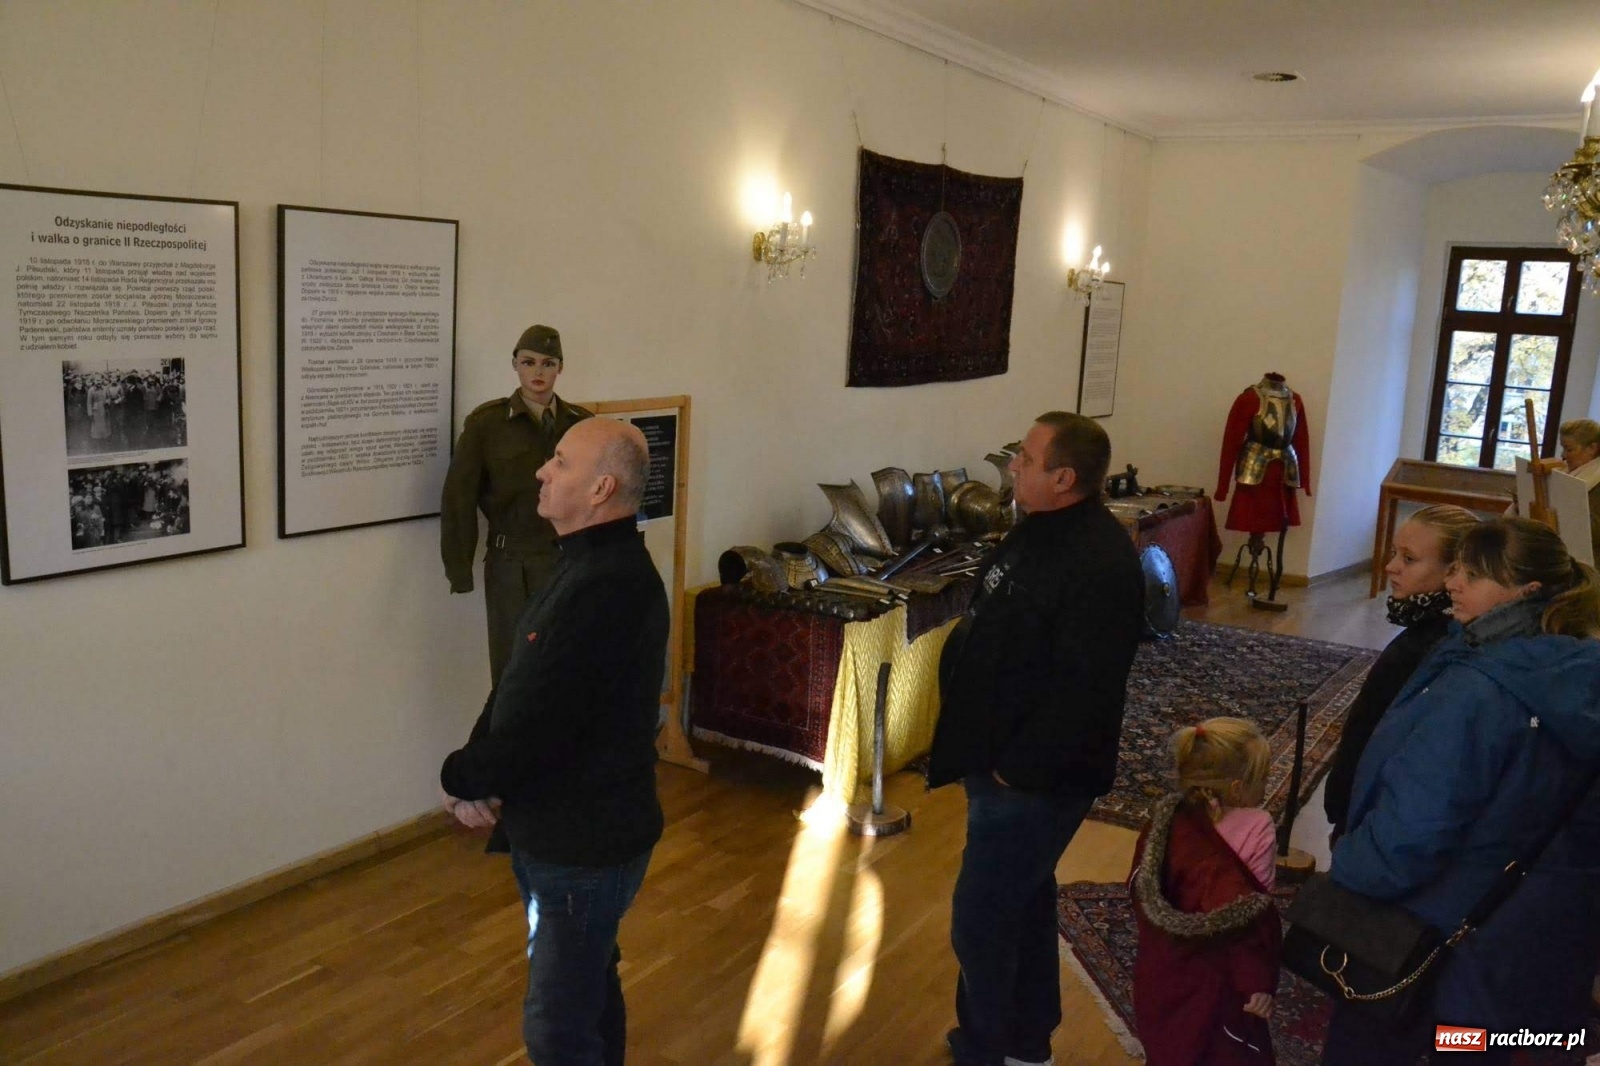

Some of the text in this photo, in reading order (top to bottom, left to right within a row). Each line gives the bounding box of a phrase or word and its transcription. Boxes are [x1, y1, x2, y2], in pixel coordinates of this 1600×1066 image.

[55, 215, 186, 234] Odzyskanie niepodległości
[31, 231, 207, 252] i walka o granice II Rzeczpospolitej
